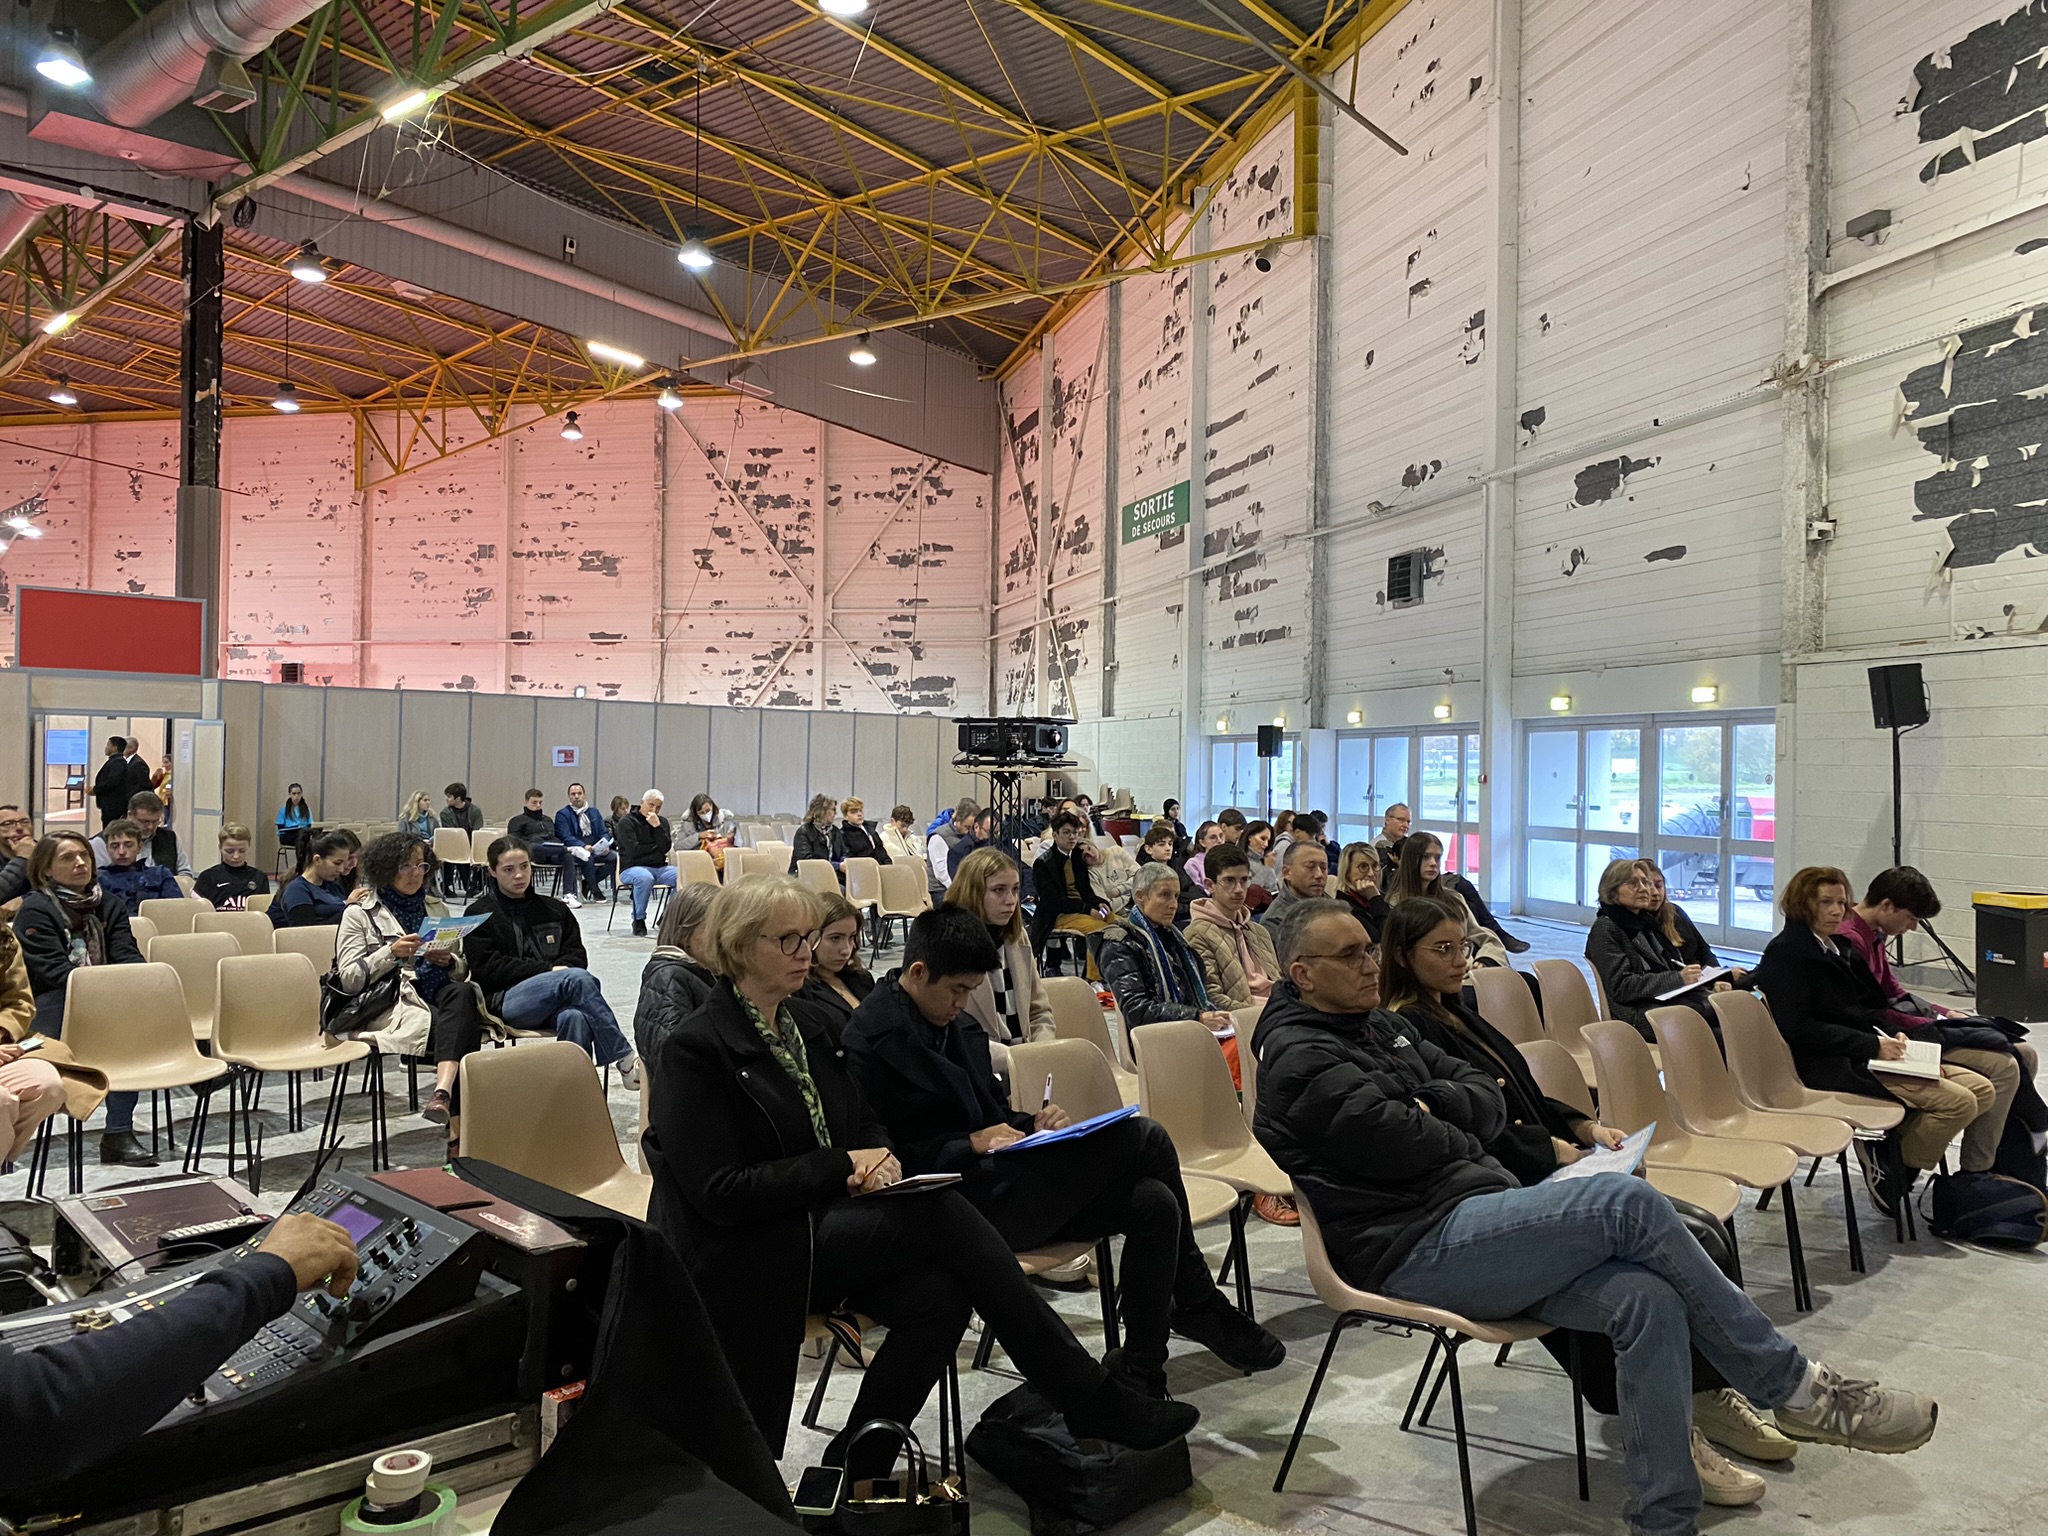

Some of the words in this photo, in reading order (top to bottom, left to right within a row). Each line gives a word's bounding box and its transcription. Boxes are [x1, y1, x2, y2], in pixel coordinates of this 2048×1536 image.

[1133, 489, 1174, 521] SORTIE
[1131, 524, 1140, 538] DE
[1142, 512, 1176, 534] SECOURS
